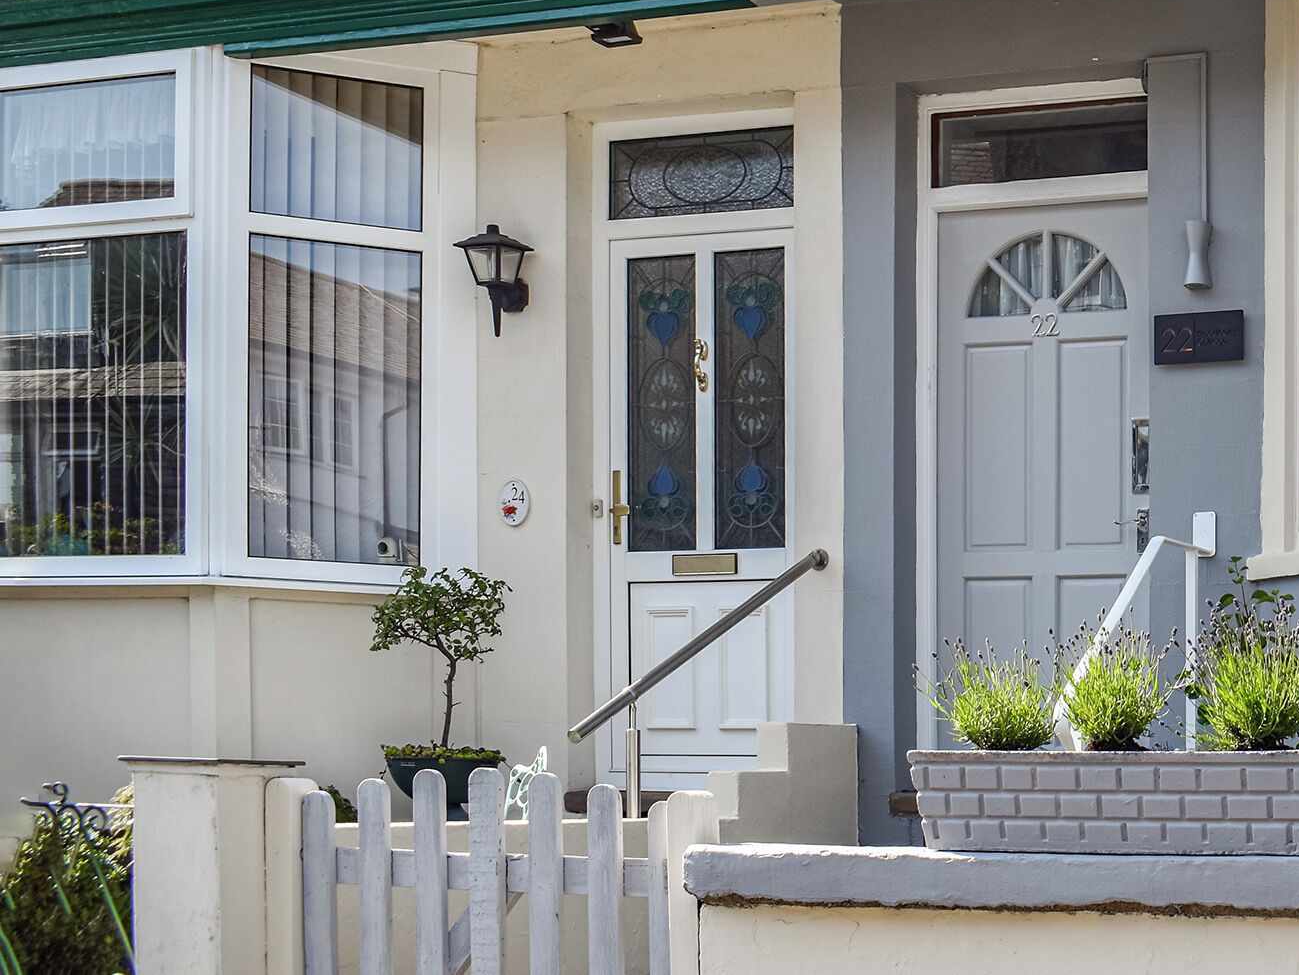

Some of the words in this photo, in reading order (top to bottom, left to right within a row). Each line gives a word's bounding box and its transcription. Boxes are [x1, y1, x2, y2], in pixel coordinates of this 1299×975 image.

[1031, 312, 1060, 338] 22
[1161, 327, 1193, 354] 22
[511, 487, 526, 504] 24
